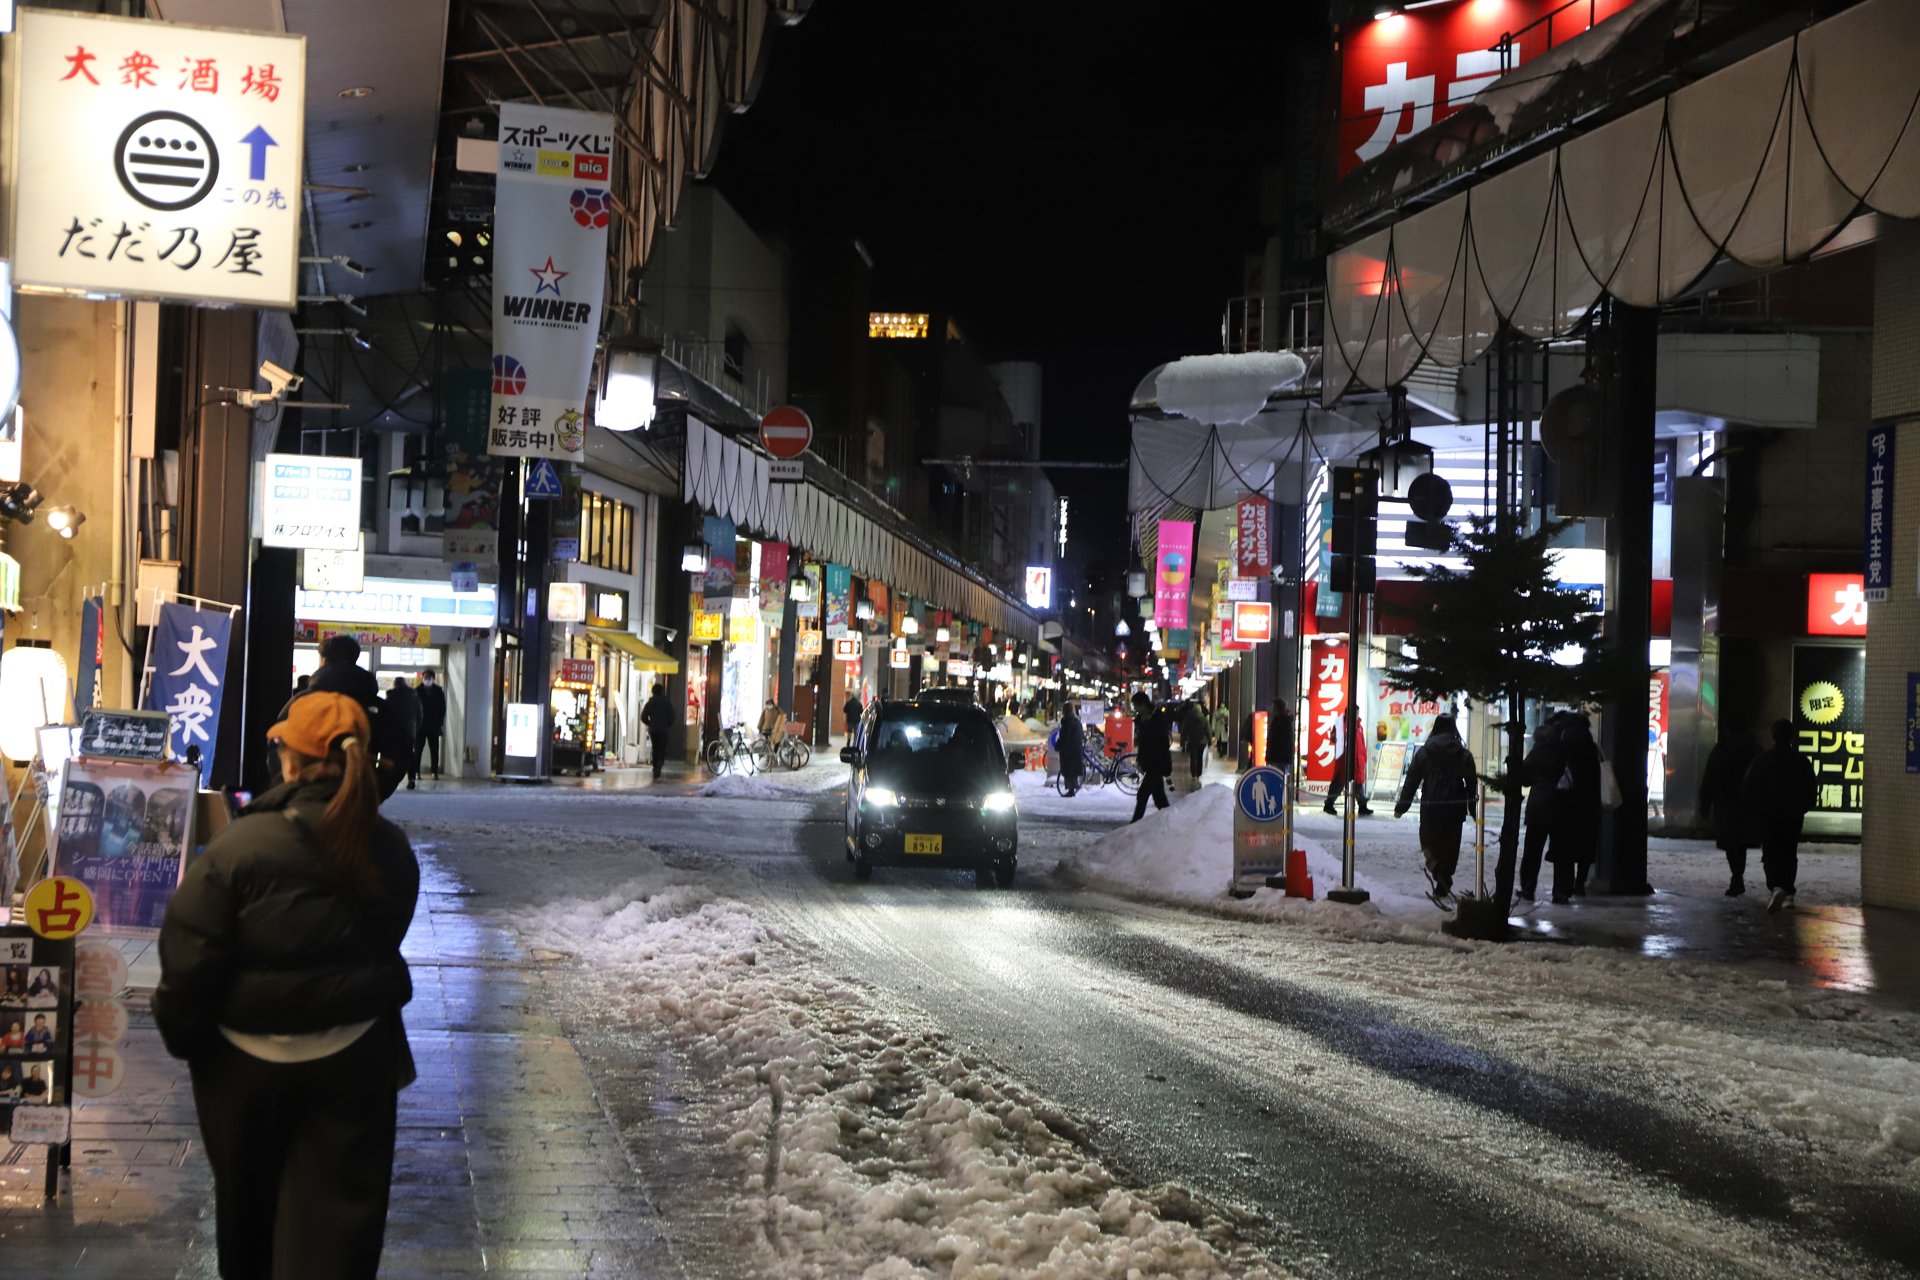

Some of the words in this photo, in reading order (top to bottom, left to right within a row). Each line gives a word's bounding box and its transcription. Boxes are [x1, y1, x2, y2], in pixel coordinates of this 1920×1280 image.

[59, 45, 283, 103] 大衆酒場
[503, 125, 611, 154] スポーツくじ
[504, 161, 532, 170] WINNER
[221, 187, 287, 211] この先
[58, 216, 264, 276] だだ乃屋
[503, 295, 592, 324] WINNER
[498, 405, 541, 427] 好評
[491, 429, 555, 452] 販売中!
[1241, 503, 1256, 566] カラオケ
[1257, 504, 1268, 566] JOYSOUND
[1869, 463, 1884, 584] 立憲民主党
[165, 625, 219, 763] 大衆
[1809, 697, 1836, 711] 限定
[1908, 719, 1916, 752] つくる
[1308, 783, 1329, 793] JOYSO
[71, 851, 180, 874] シーシャ専門店
[38, 880, 81, 935] 占
[73, 951, 118, 1089] 営業中
